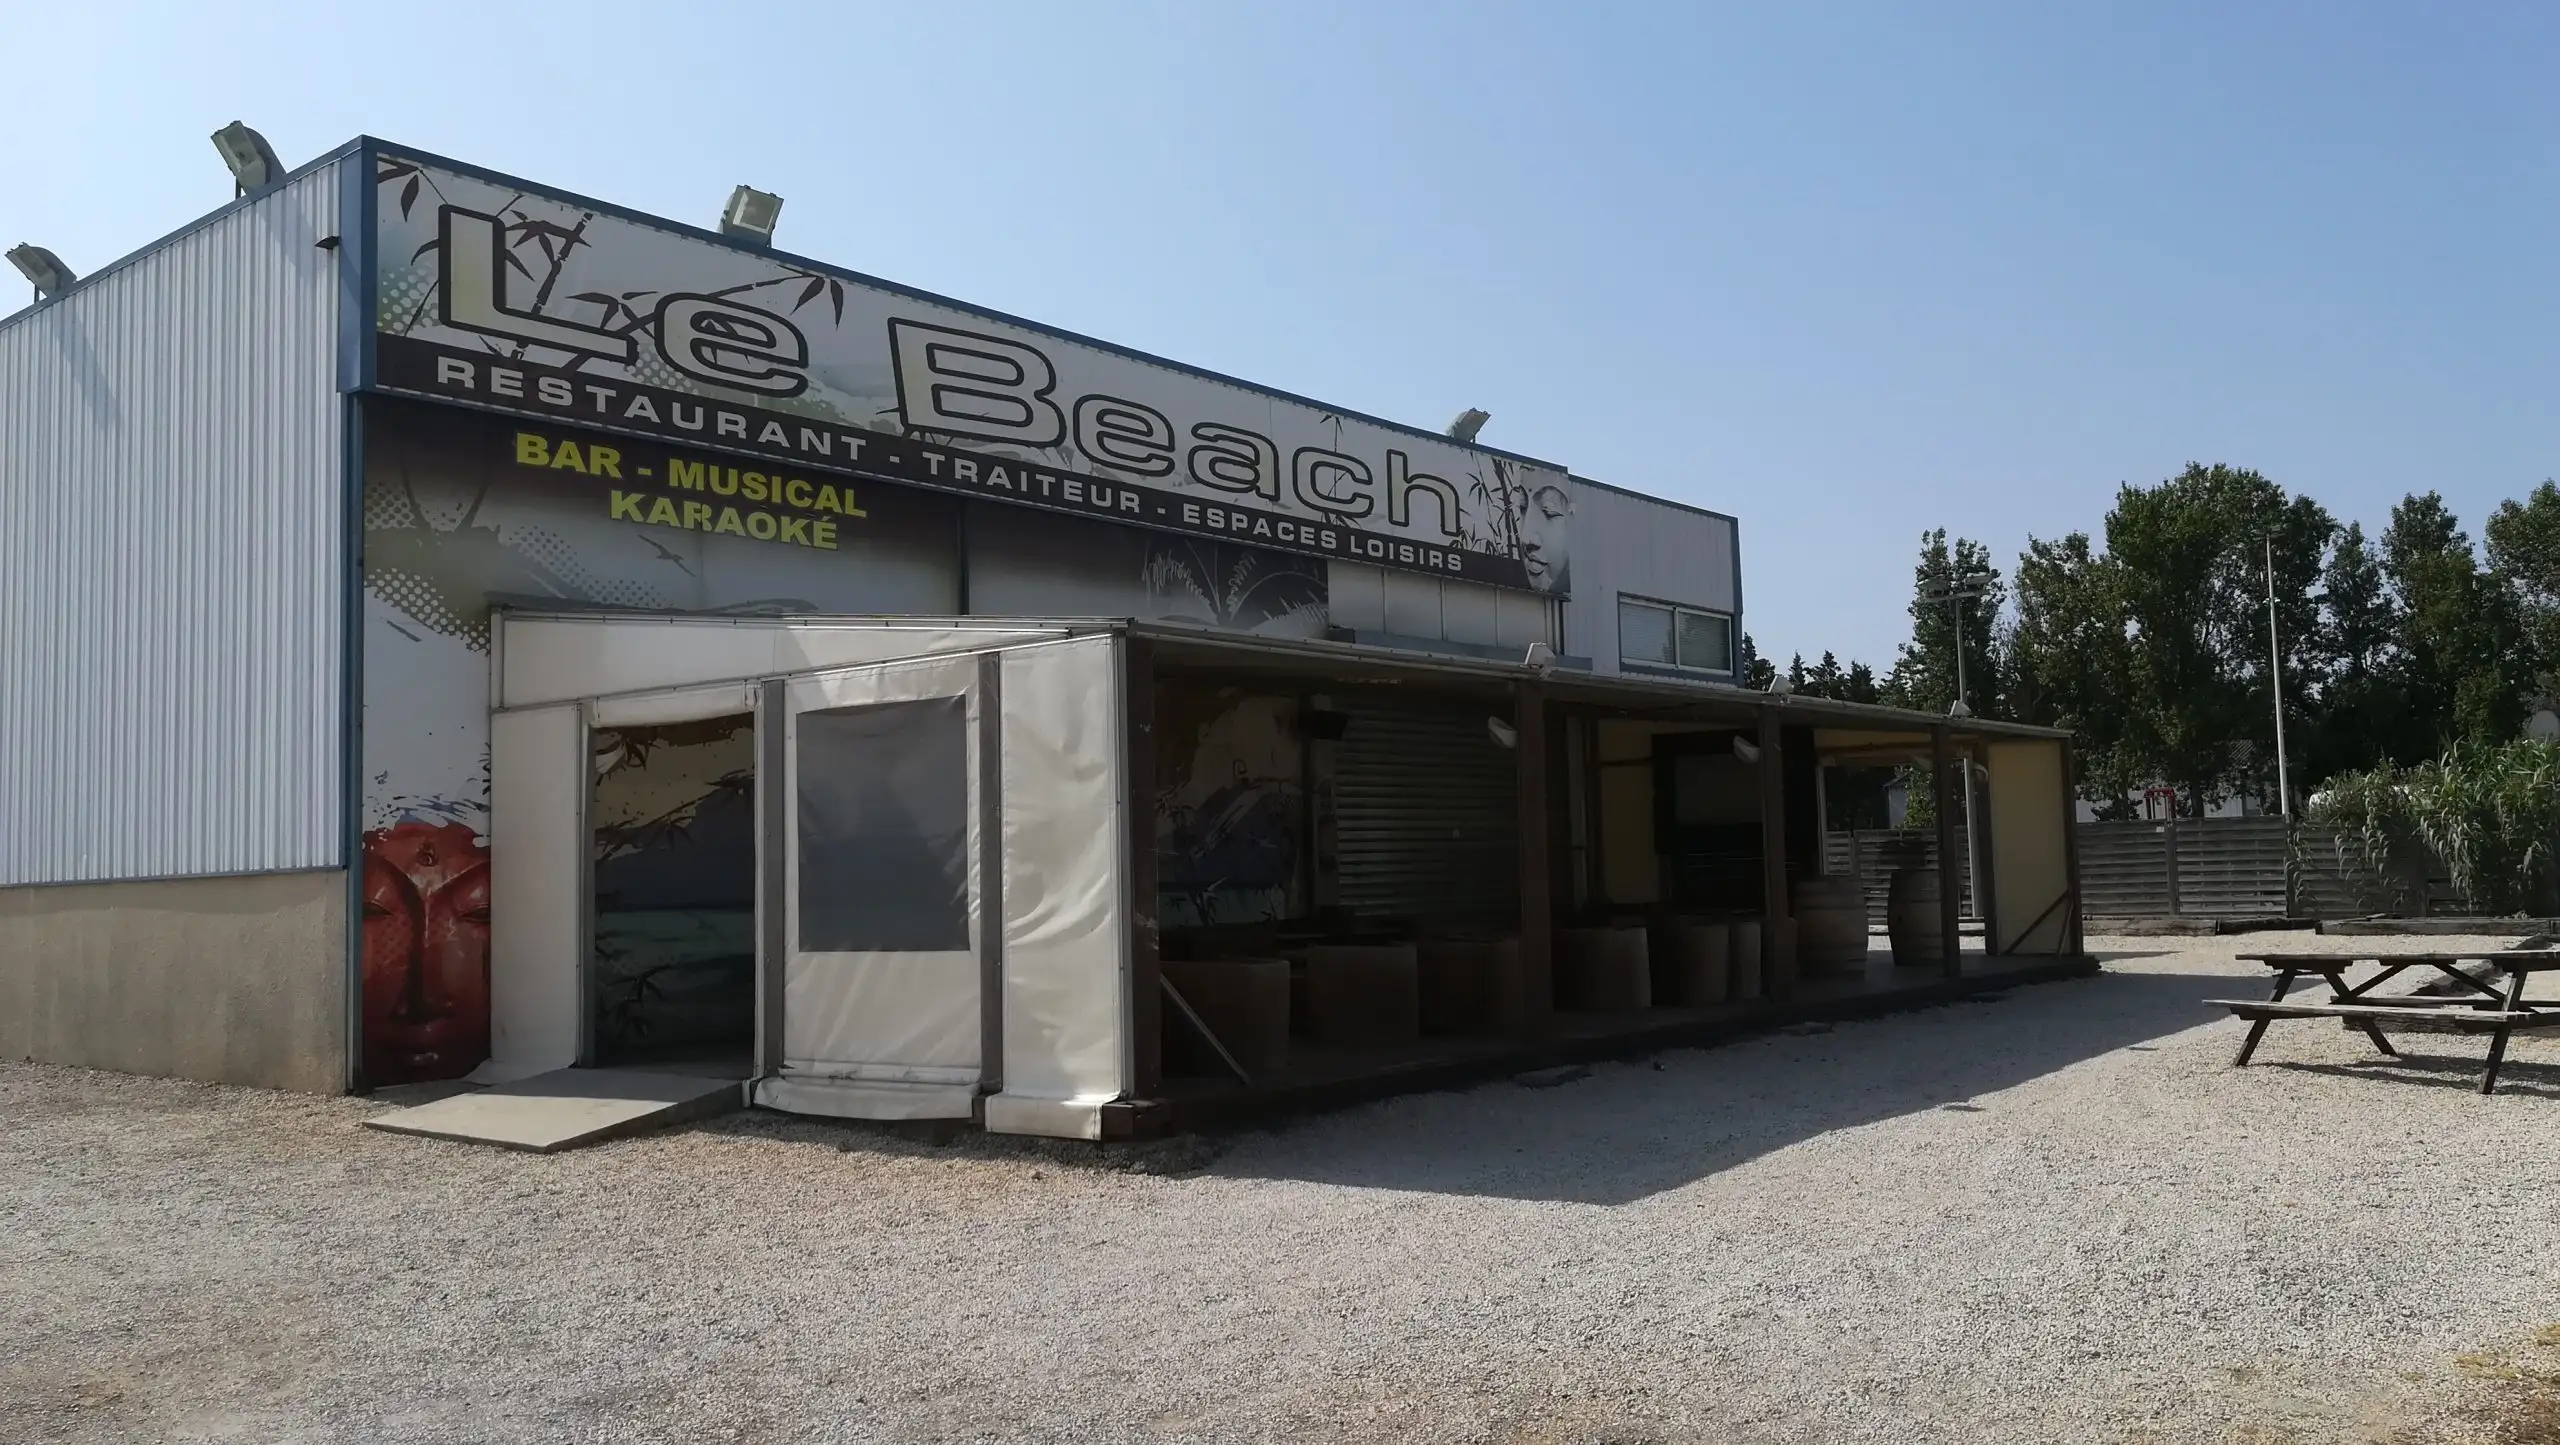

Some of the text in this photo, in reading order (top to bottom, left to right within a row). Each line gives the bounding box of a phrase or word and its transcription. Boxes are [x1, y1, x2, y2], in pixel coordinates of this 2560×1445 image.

[438, 203, 1461, 536] Le Beach
[437, 356, 866, 461] RESTAURANT
[922, 451, 1141, 514] TRAITEUR
[1183, 505, 1337, 550] ESPACES
[1350, 535, 1462, 572] LOISIRS
[516, 433, 622, 480] BAR
[668, 457, 868, 518] MUSICAL
[610, 490, 839, 551] KARAOKÉ
